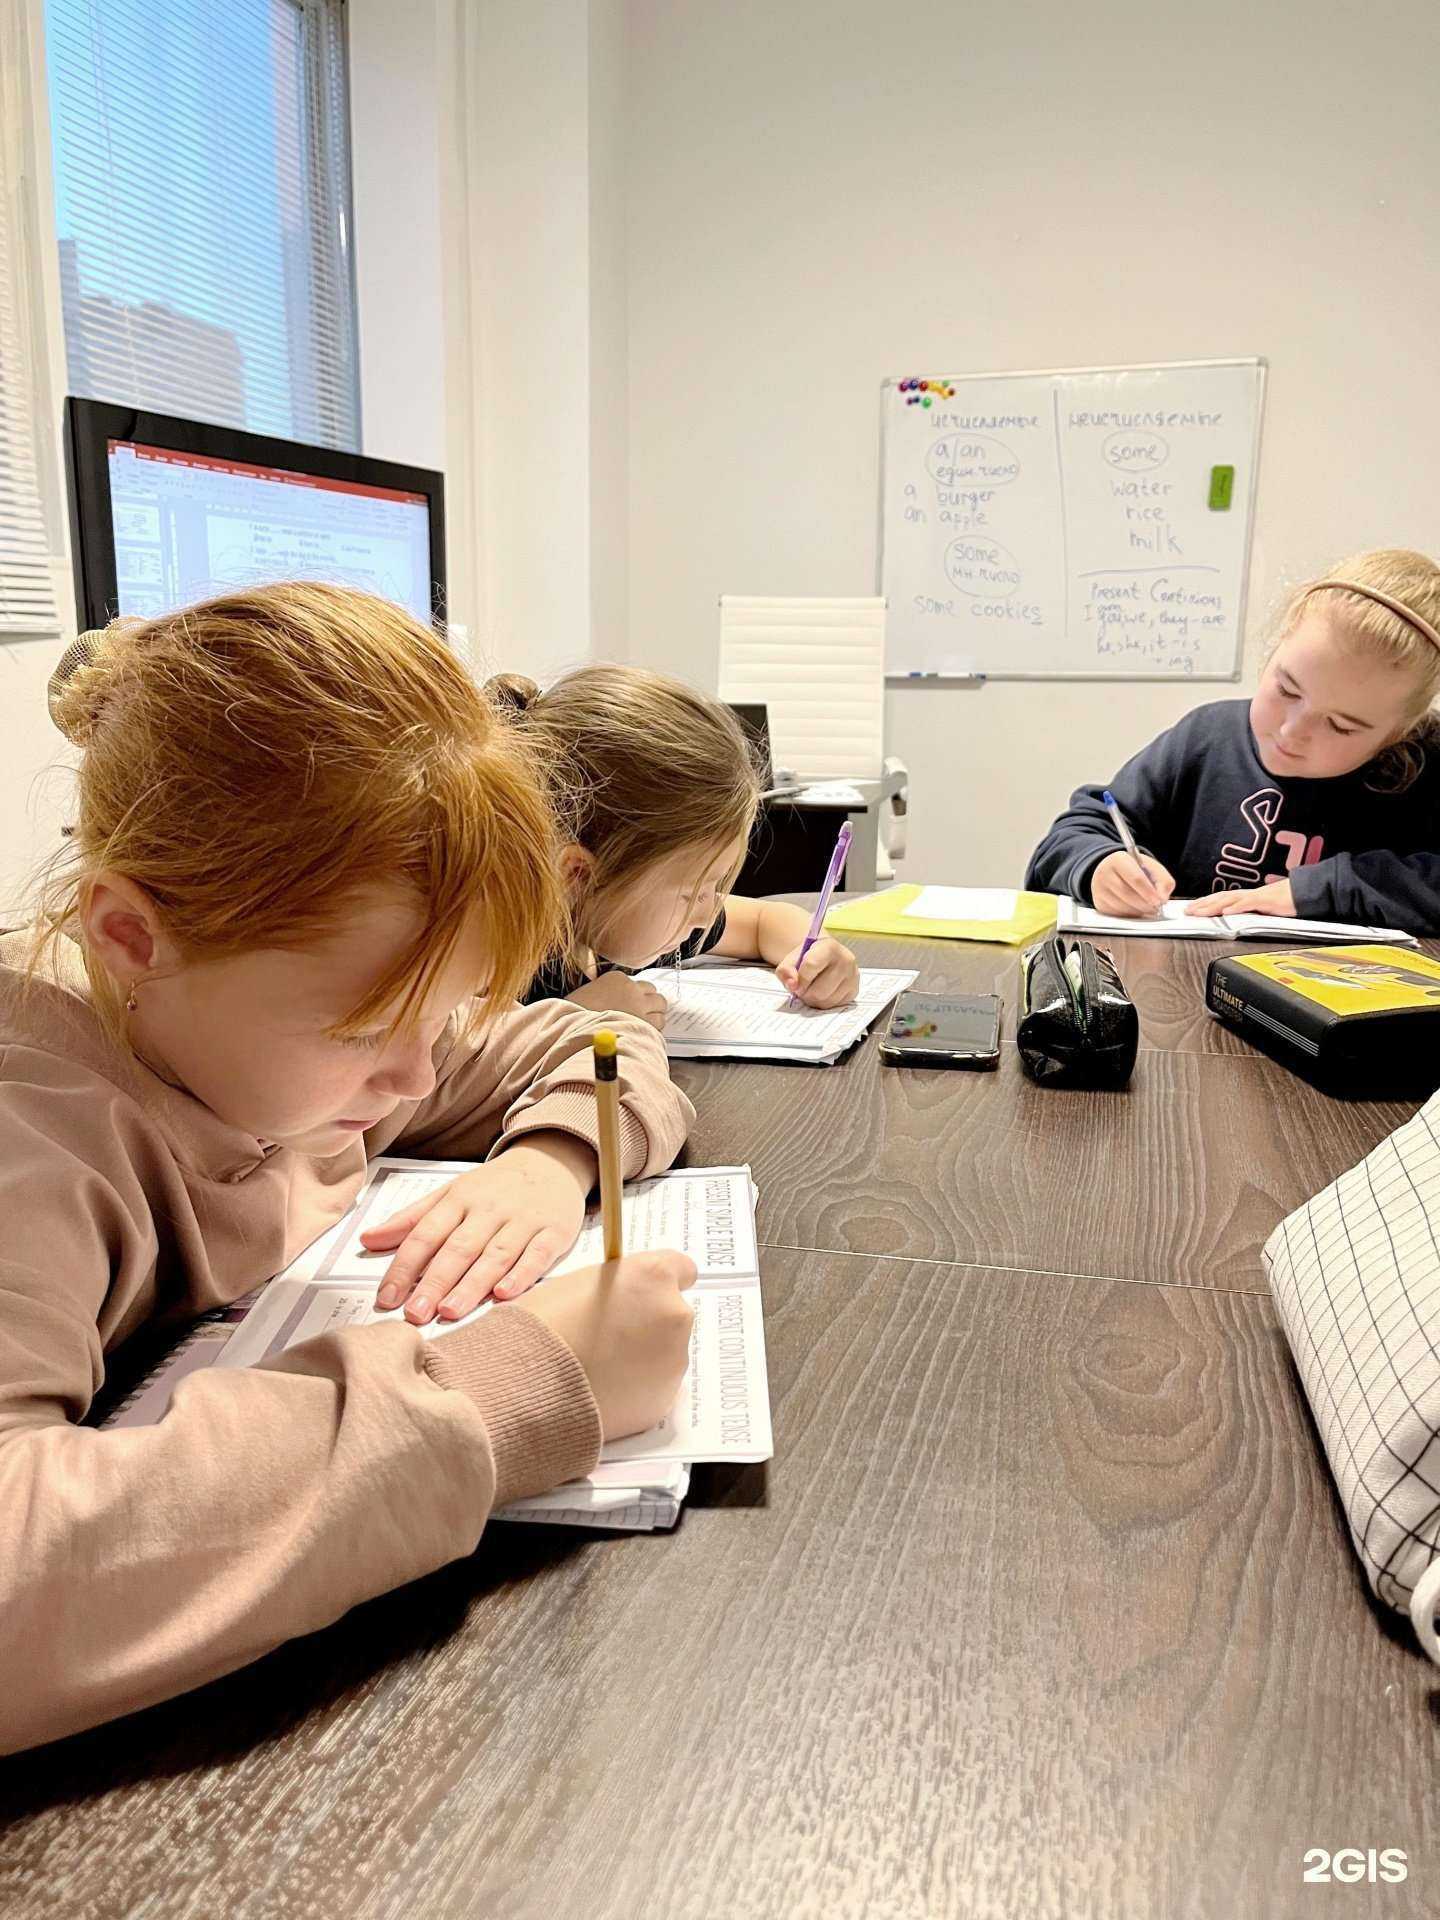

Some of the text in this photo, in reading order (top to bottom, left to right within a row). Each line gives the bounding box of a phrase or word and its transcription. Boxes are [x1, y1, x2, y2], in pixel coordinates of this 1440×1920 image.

[904, 483, 995, 511] a burger
[904, 506, 988, 529] an apple
[1126, 506, 1165, 521] rice
[1129, 524, 1183, 554] milk
[1092, 582, 1140, 601] Present
[970, 601, 1042, 620] cookies
[1212, 985, 1244, 1012] ULTIMATE
[705, 1179, 732, 1206] PRESENT
[707, 1237, 736, 1267] TENSE
[718, 1295, 751, 1445] PRESENT CONTINUOUS TENSE
